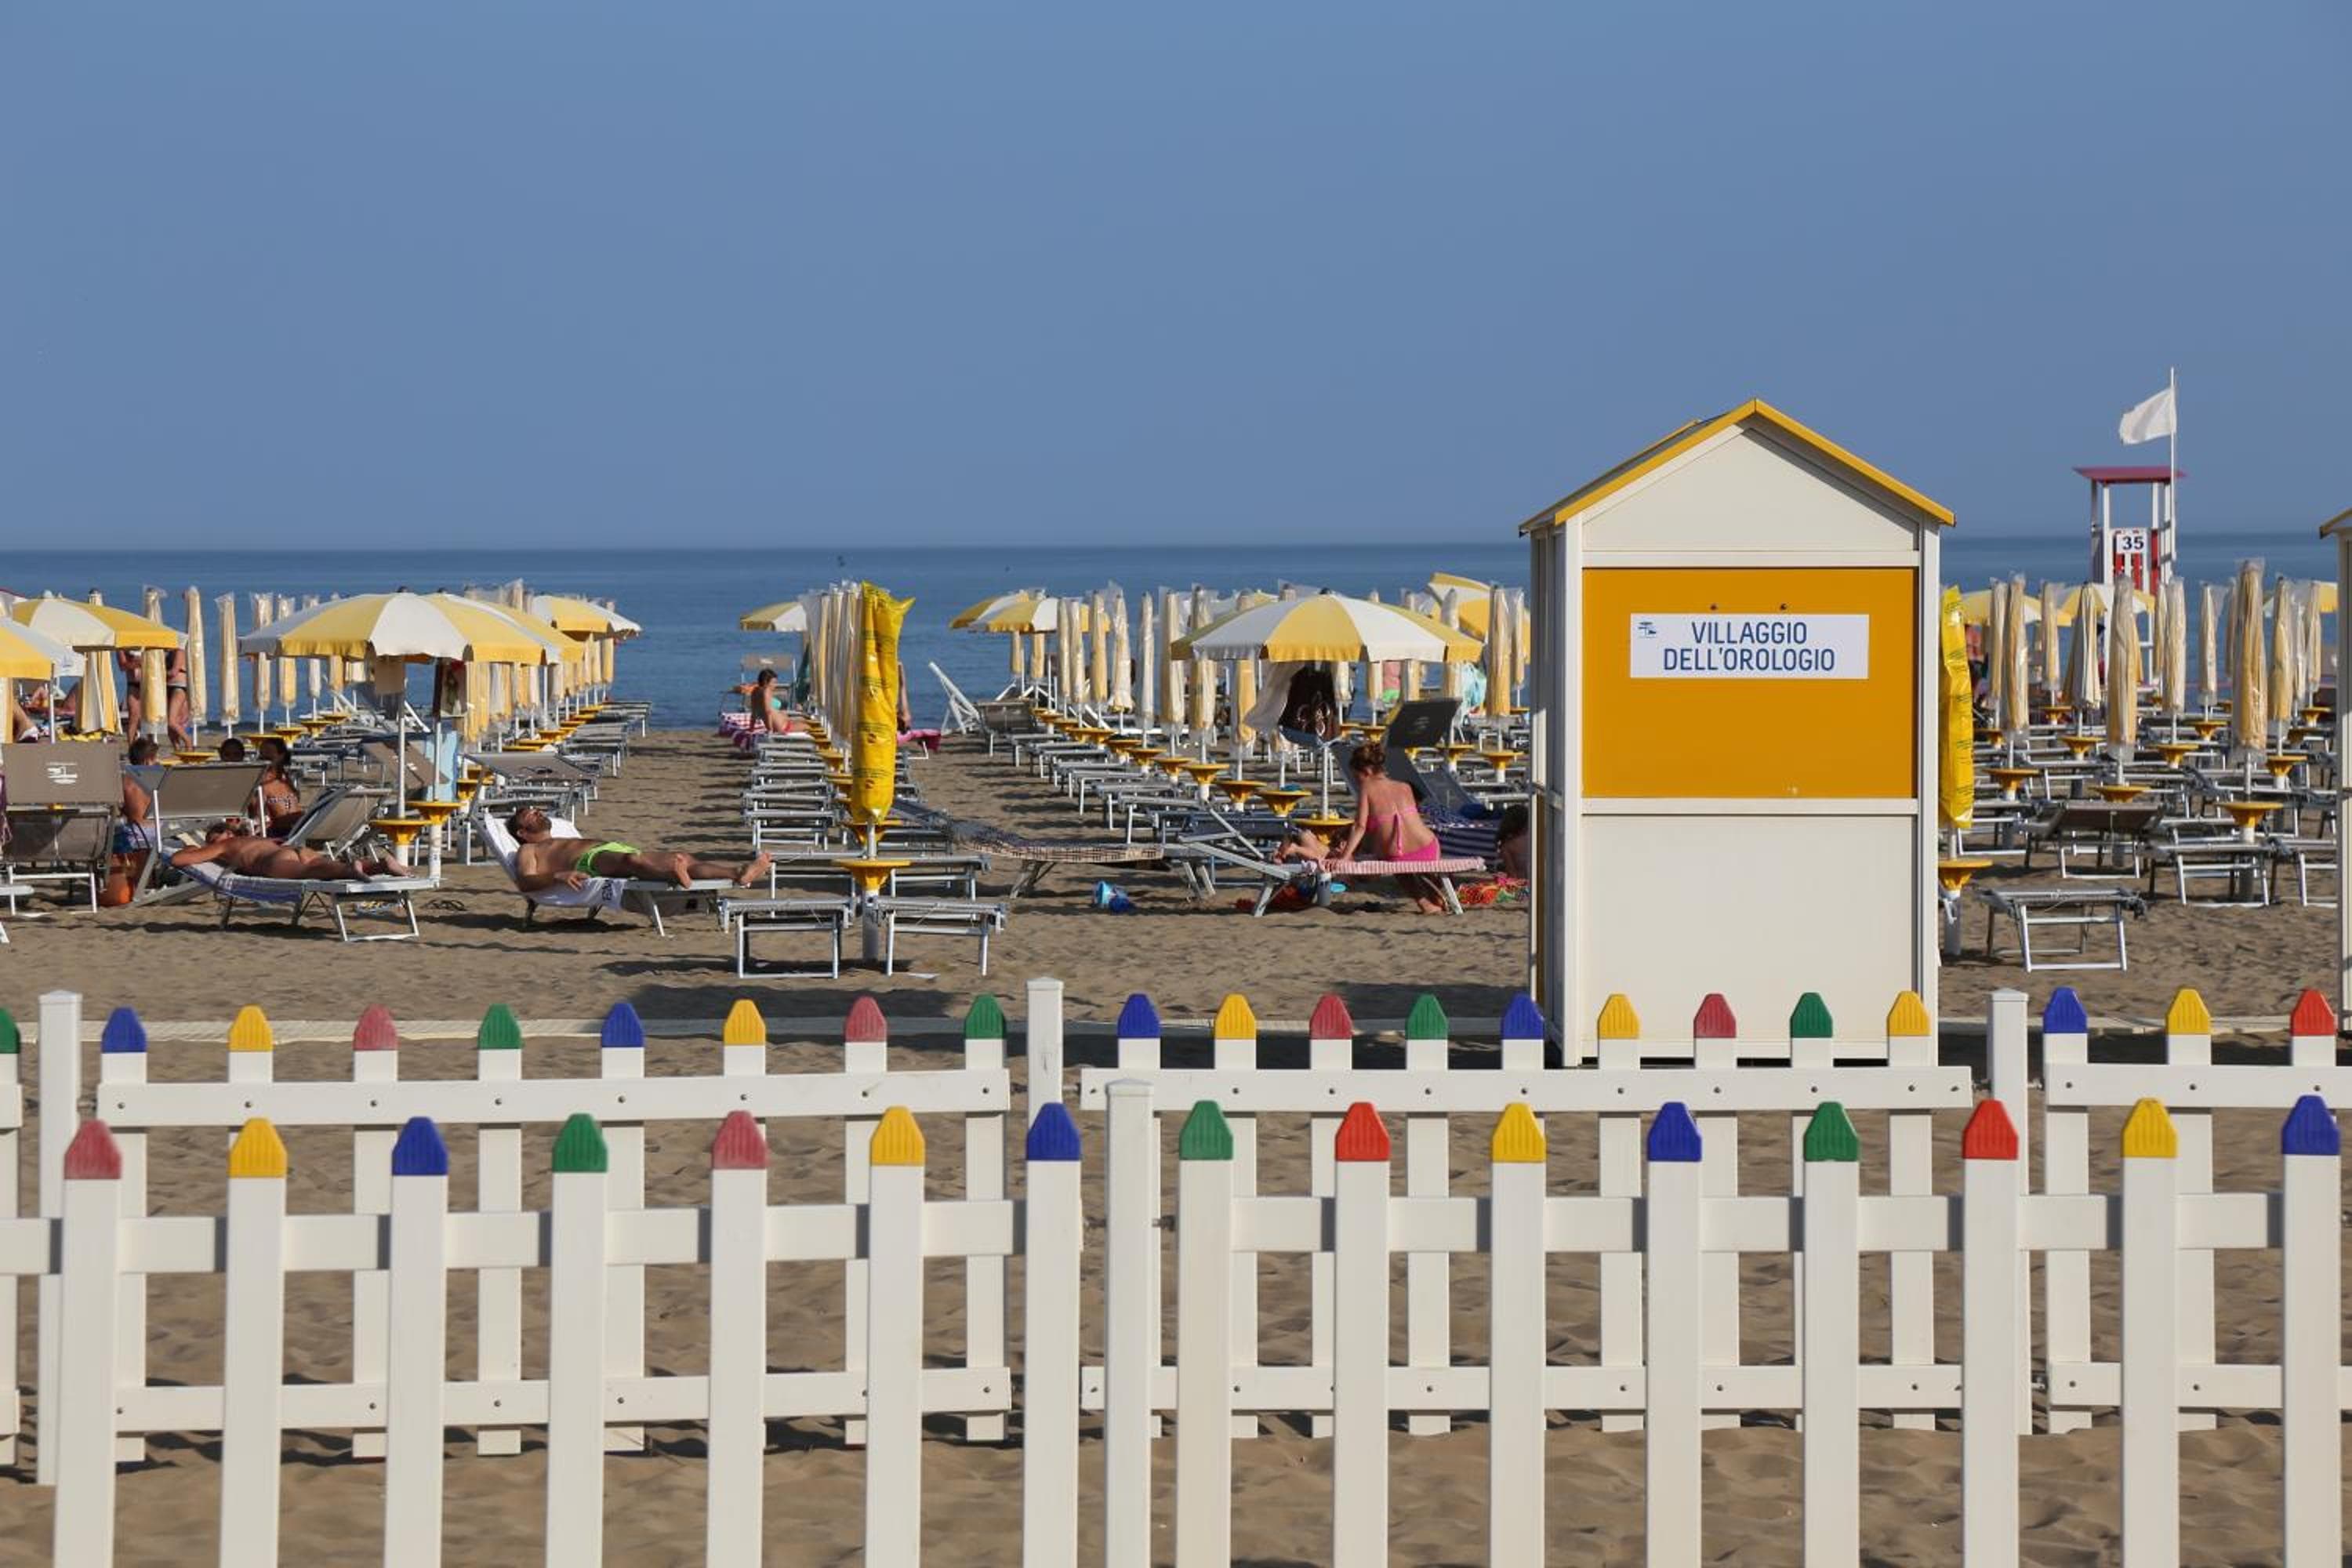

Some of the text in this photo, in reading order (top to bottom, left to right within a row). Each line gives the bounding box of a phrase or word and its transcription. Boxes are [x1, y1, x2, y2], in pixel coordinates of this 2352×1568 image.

[2122, 535, 2144, 550] 35
[1691, 622, 1807, 644] VILLAGGIO
[1663, 648, 1835, 671] DELL'OROLOGIO
